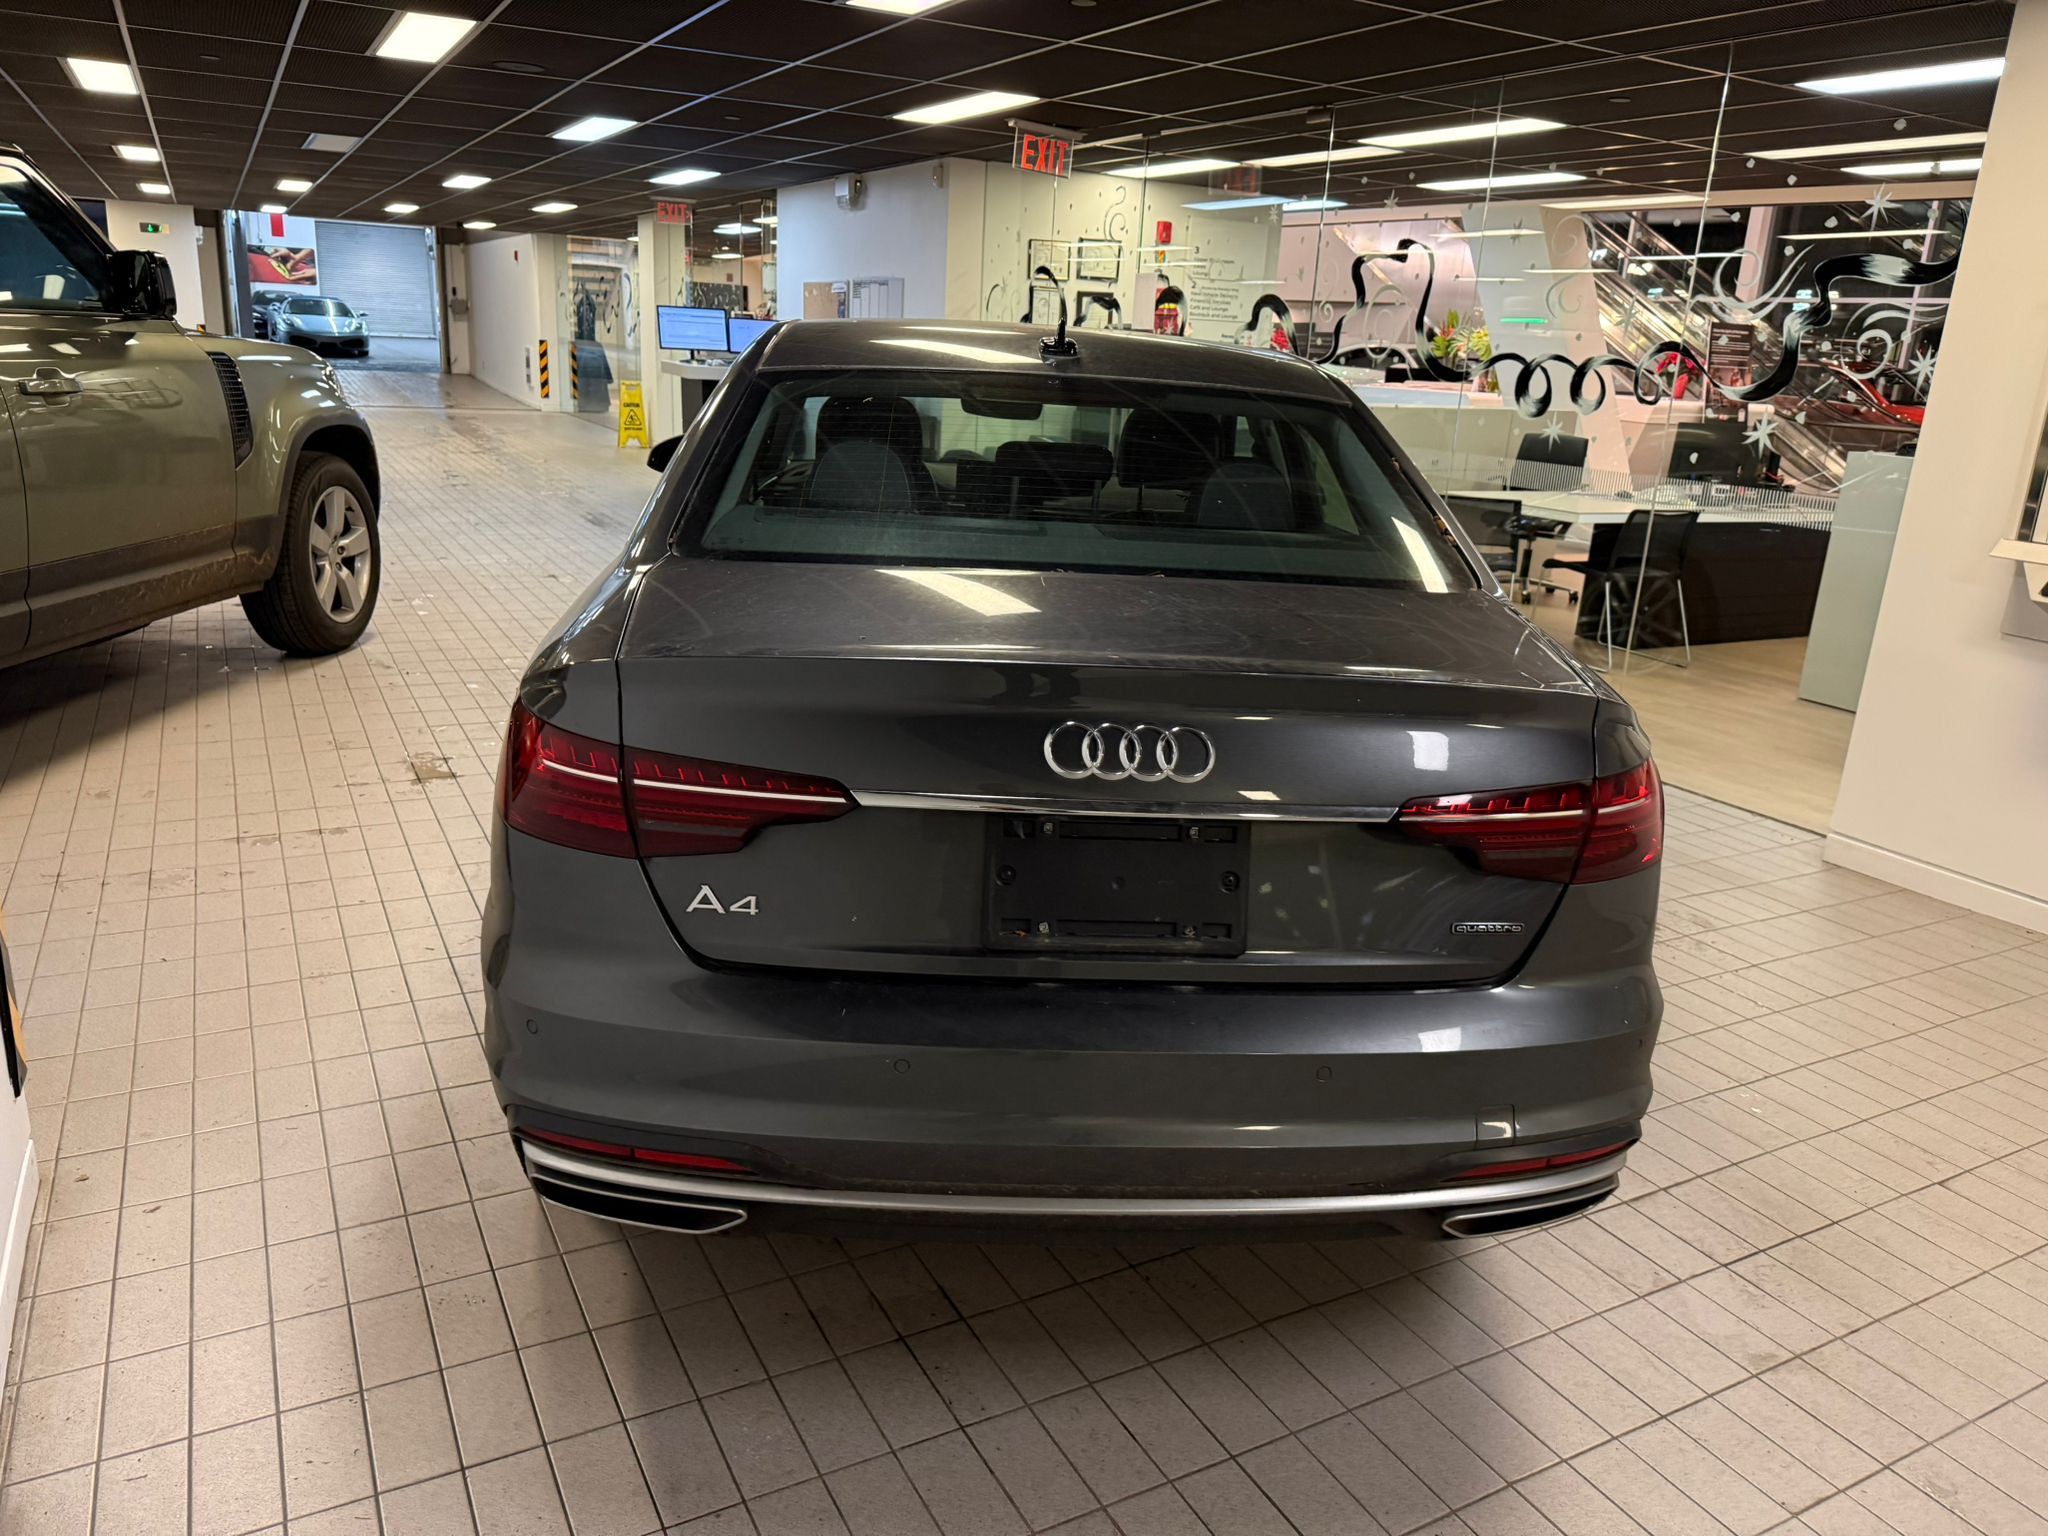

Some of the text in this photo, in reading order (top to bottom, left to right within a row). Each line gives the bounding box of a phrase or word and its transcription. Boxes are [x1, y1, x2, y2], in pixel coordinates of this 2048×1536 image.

[1020, 134, 1068, 176] EXIT
[657, 202, 687, 223] EXIT
[1194, 246, 1200, 255] 3
[686, 884, 759, 915] A4
[1456, 925, 1522, 934] quattro
